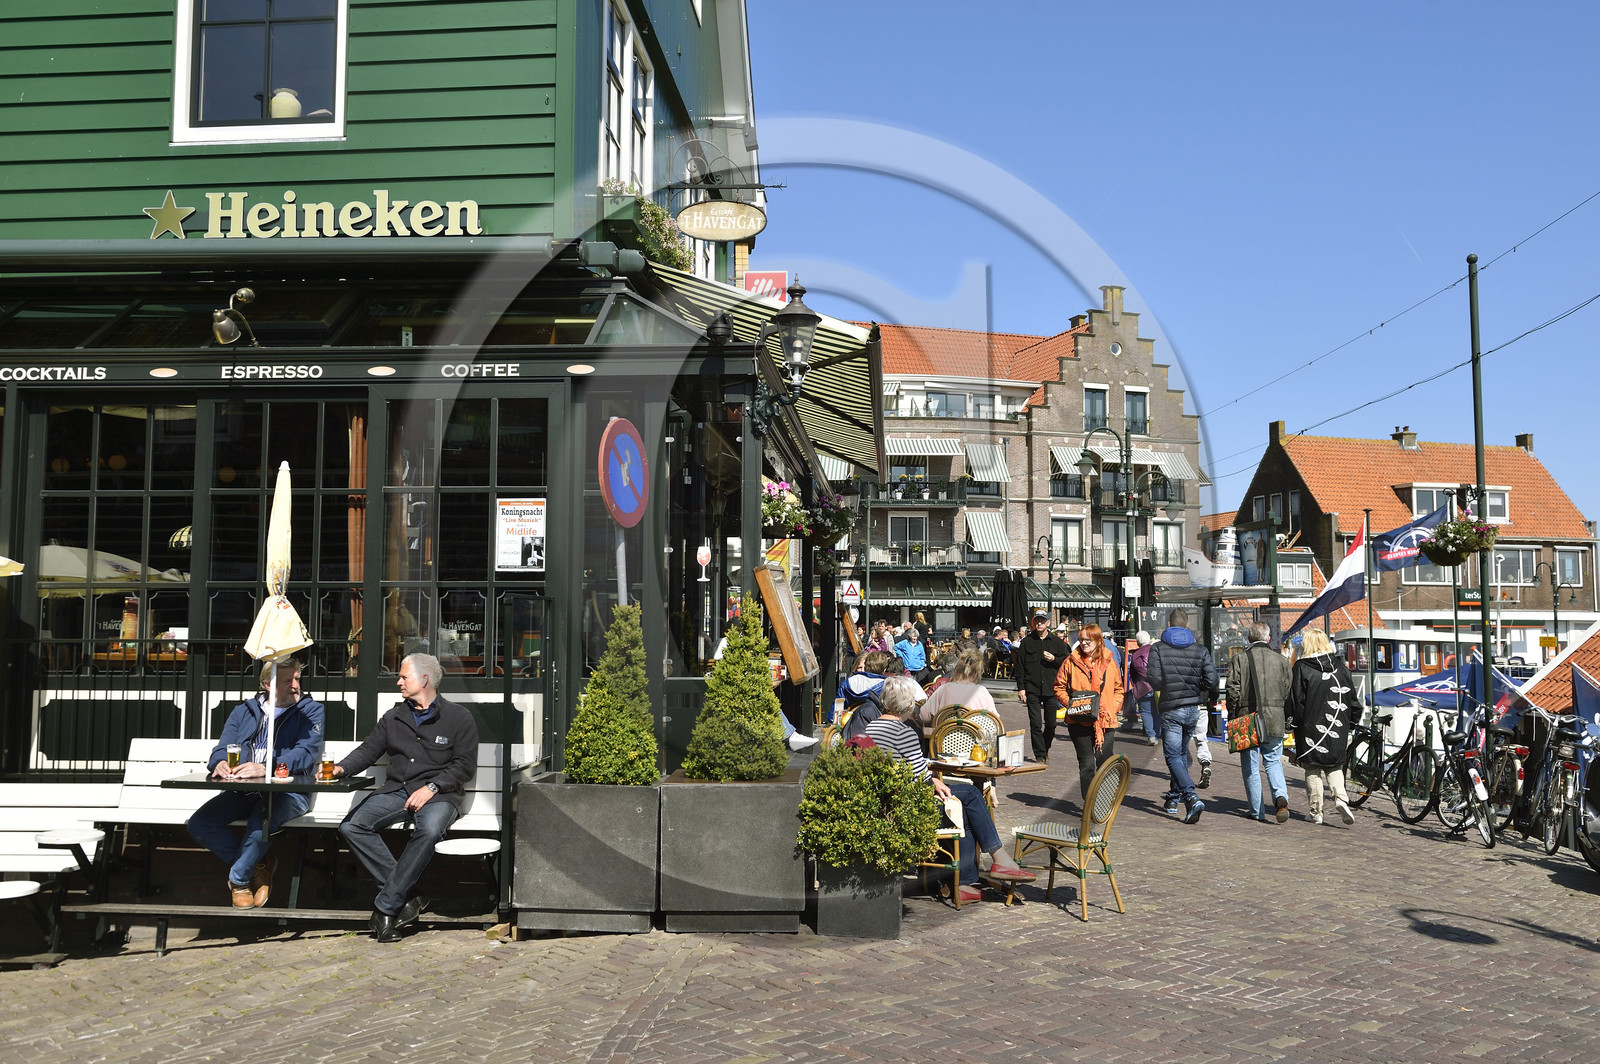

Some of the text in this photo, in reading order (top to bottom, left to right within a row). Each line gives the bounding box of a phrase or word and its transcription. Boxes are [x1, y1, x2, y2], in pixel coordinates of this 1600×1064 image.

[204, 189, 483, 239] Heineken
[751, 278, 783, 300] illy
[0, 367, 107, 381] COCKTAILS
[220, 365, 323, 379] ESPRESSO
[440, 363, 520, 378] COFFEE
[501, 507, 543, 518] Koningsnacht
[506, 527, 538, 536] Midlife
[1067, 704, 1092, 715] HOLLAND
